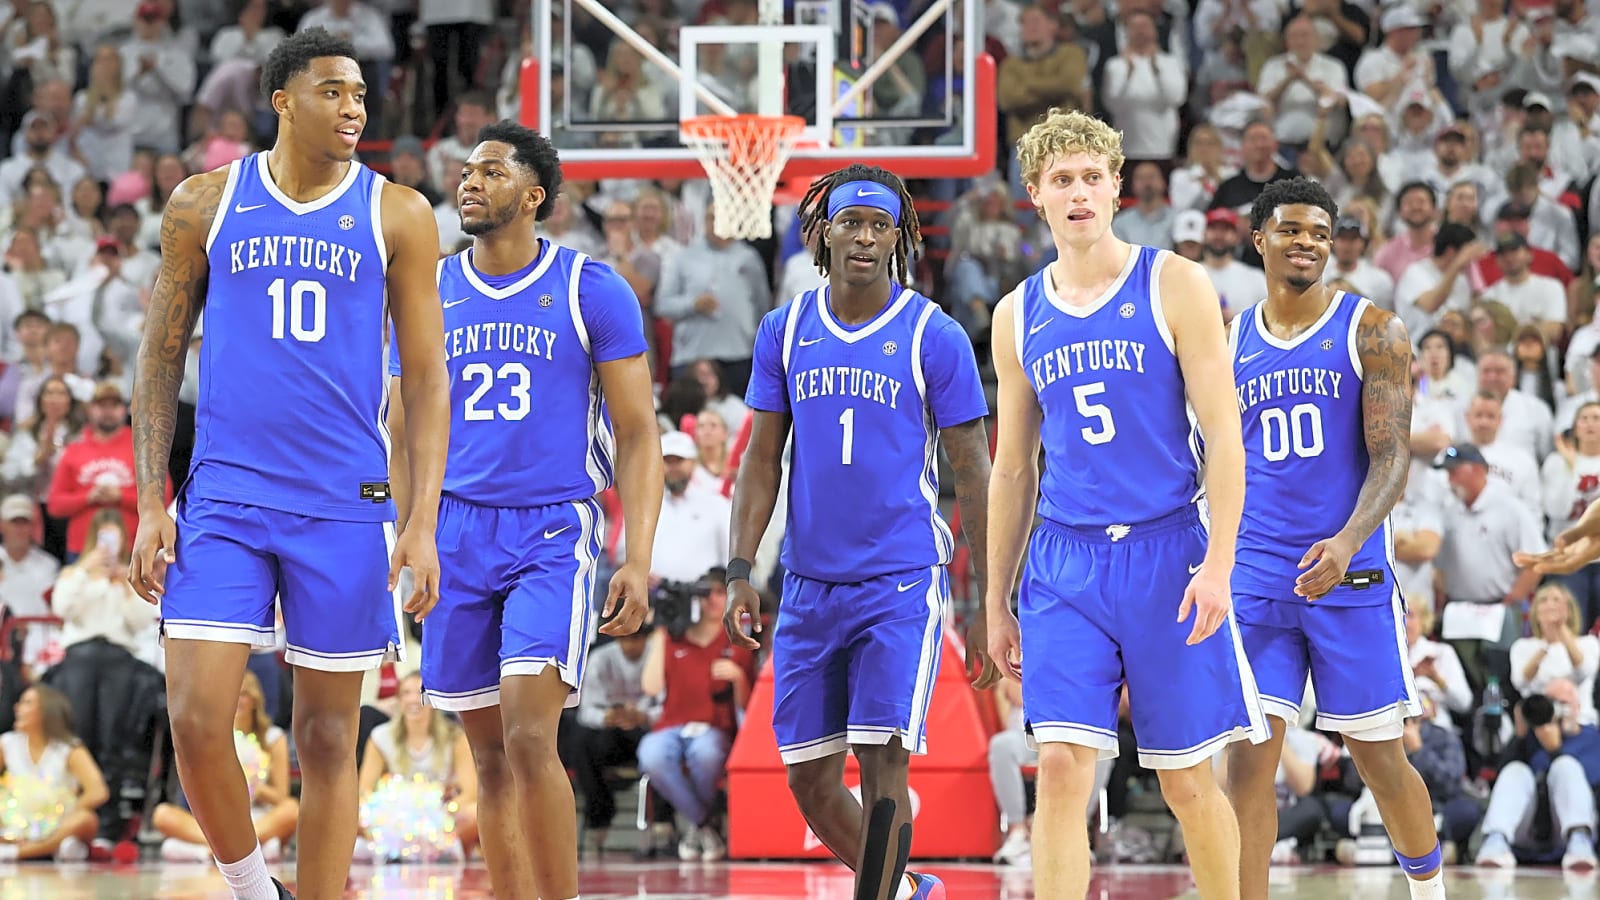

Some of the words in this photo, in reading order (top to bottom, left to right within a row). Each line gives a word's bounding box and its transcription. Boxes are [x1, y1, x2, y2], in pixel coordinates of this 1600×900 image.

[230, 236, 362, 283] KENTUCKY
[267, 278, 327, 342] 10
[539, 294, 553, 307] SEC
[461, 362, 531, 421] 23
[795, 367, 902, 410] KENTUCKY
[1032, 339, 1146, 393] KENTUCKY
[1236, 367, 1342, 413] KENTUCKY
[839, 408, 854, 465] 1
[1072, 381, 1117, 446] 5
[1260, 403, 1325, 461] 00
